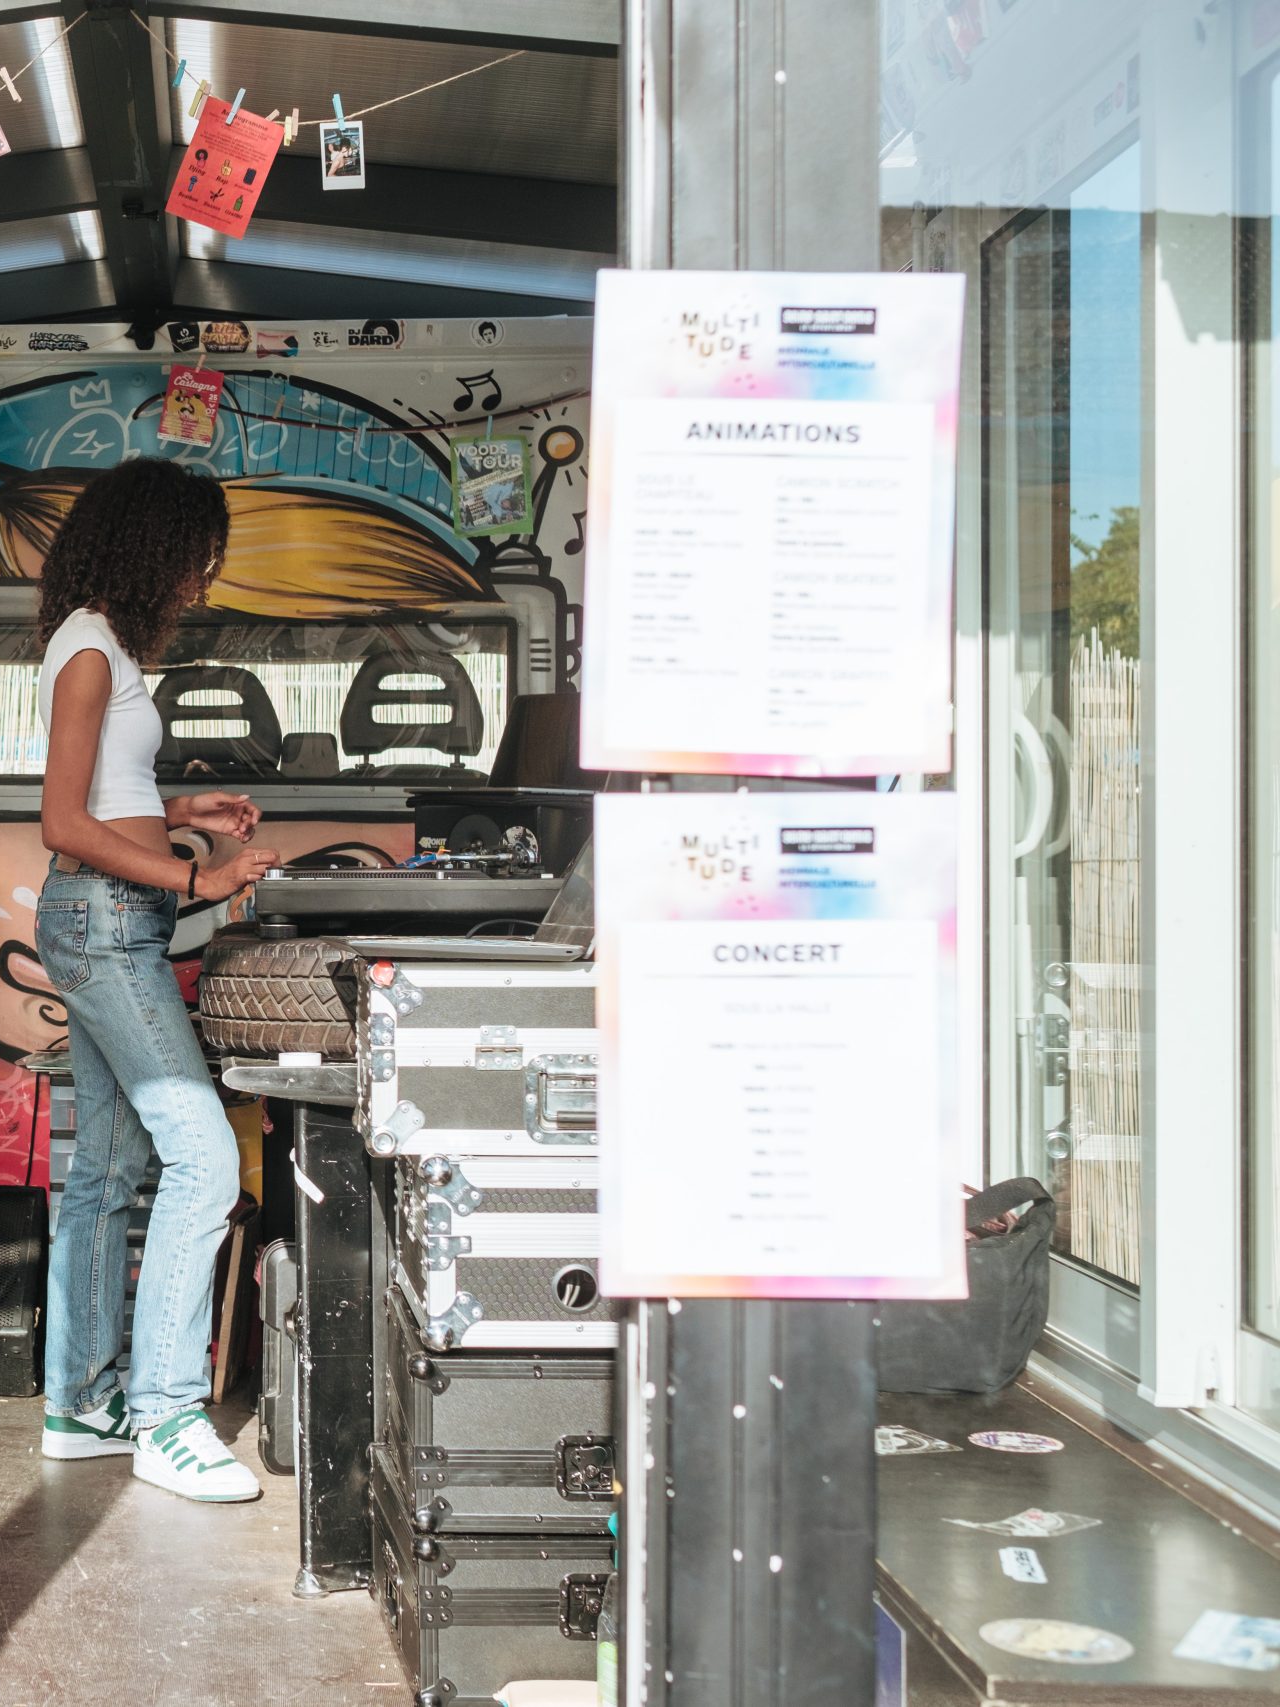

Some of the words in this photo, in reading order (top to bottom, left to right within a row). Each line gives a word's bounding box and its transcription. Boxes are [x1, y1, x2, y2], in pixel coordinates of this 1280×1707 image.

[29, 331, 85, 342] HARDCORE
[348, 335, 394, 346] DARD
[173, 376, 217, 392] Castagne
[686, 421, 862, 444] ANIMATIONS
[453, 443, 508, 457] WOODS
[471, 454, 524, 472] TOUR
[713, 944, 843, 963] CONCERT
